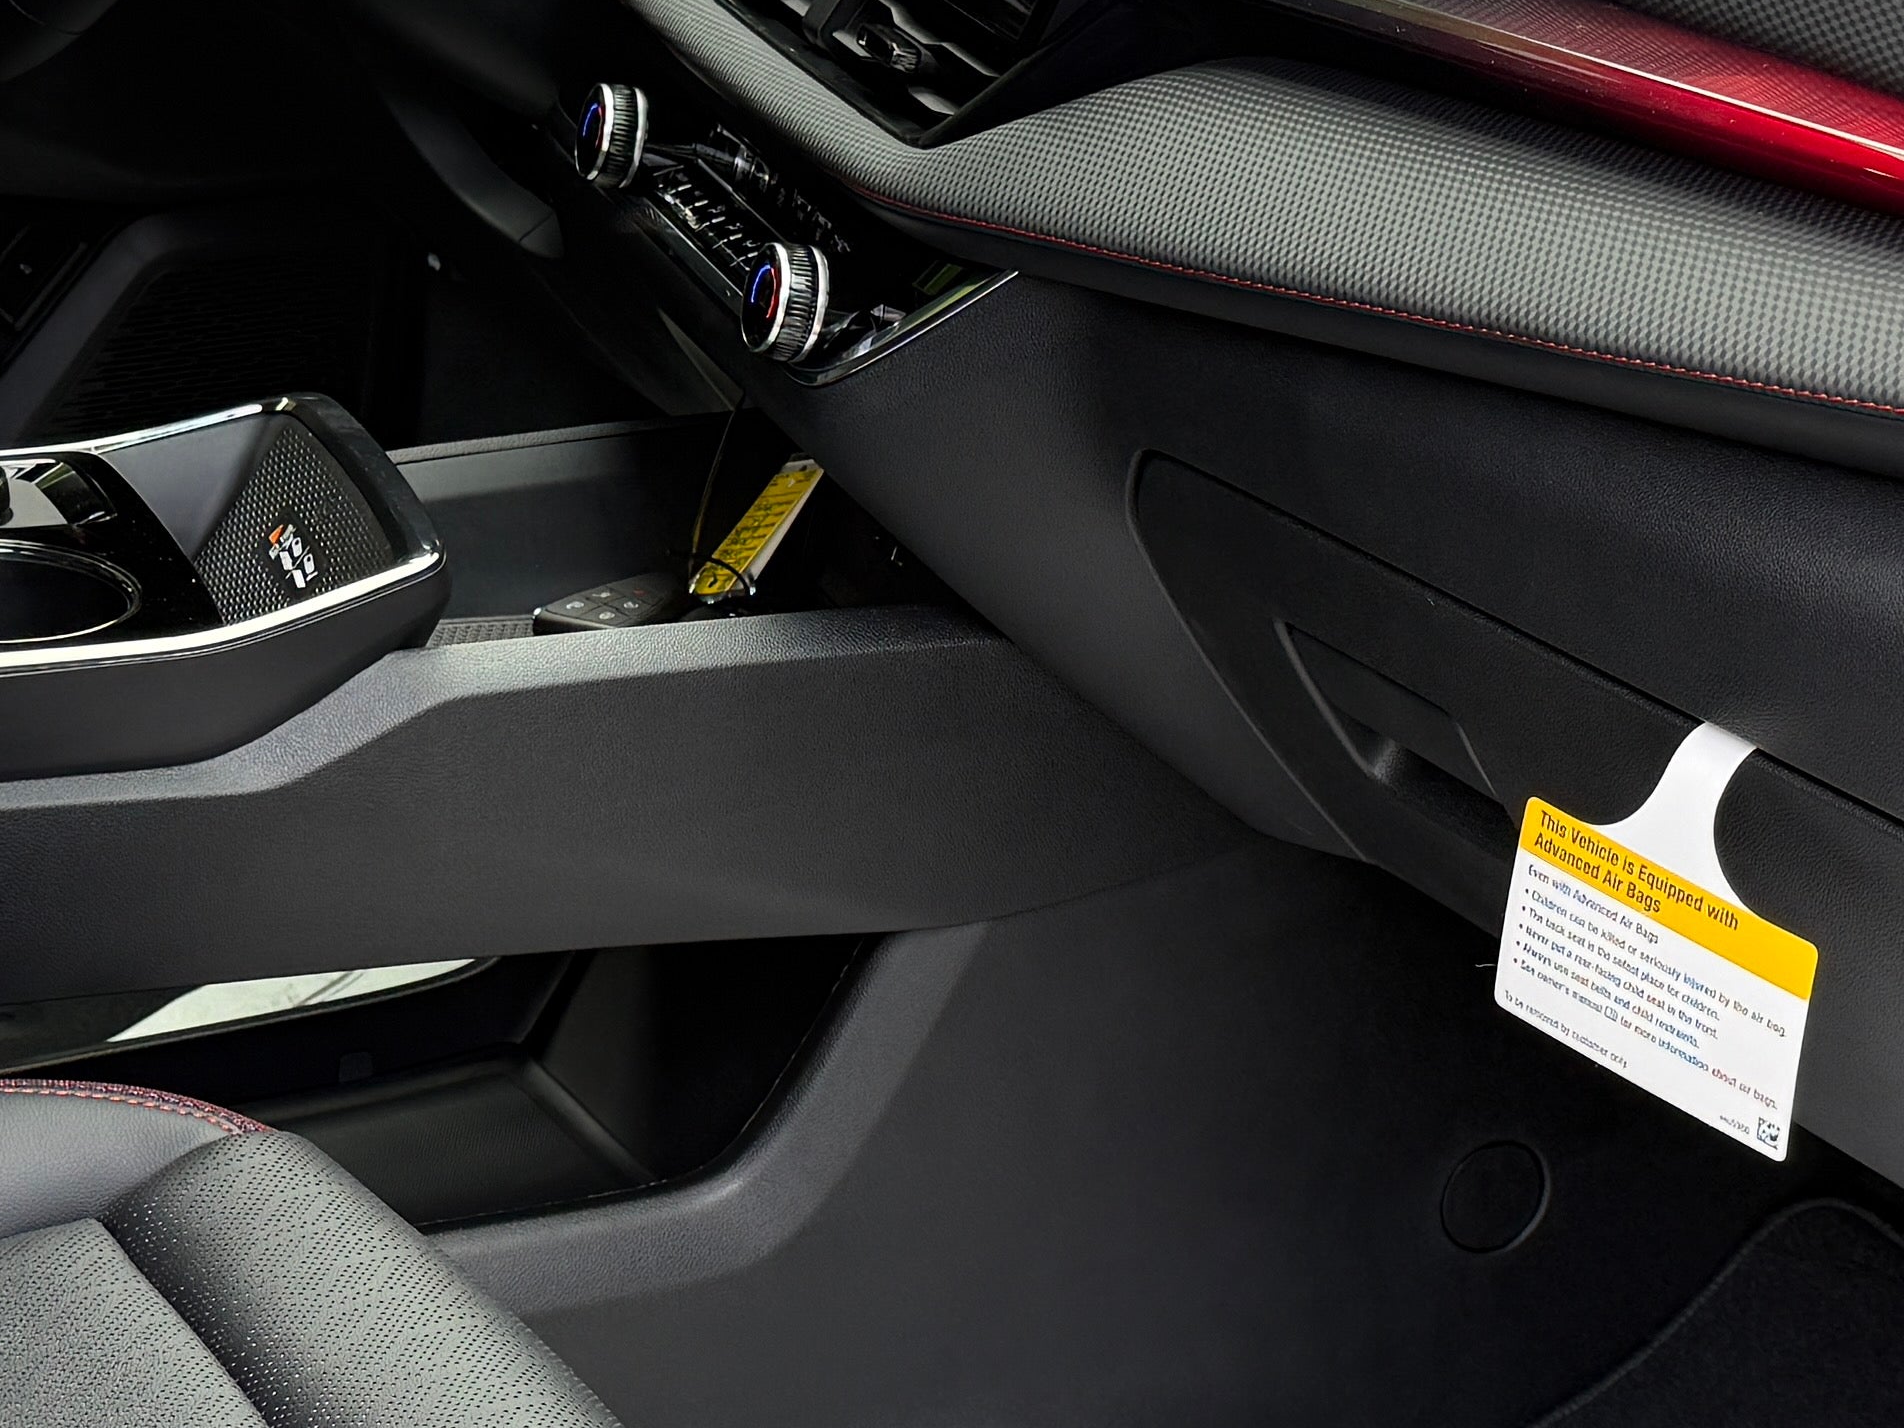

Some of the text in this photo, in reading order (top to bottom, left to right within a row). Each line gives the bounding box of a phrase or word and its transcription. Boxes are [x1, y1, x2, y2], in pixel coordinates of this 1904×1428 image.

[1534, 832, 1660, 912] Advanced Air Bags
[1571, 826, 1618, 866] Vehicle
[1638, 864, 1703, 912] Equipped
[1707, 903, 1738, 930] with
